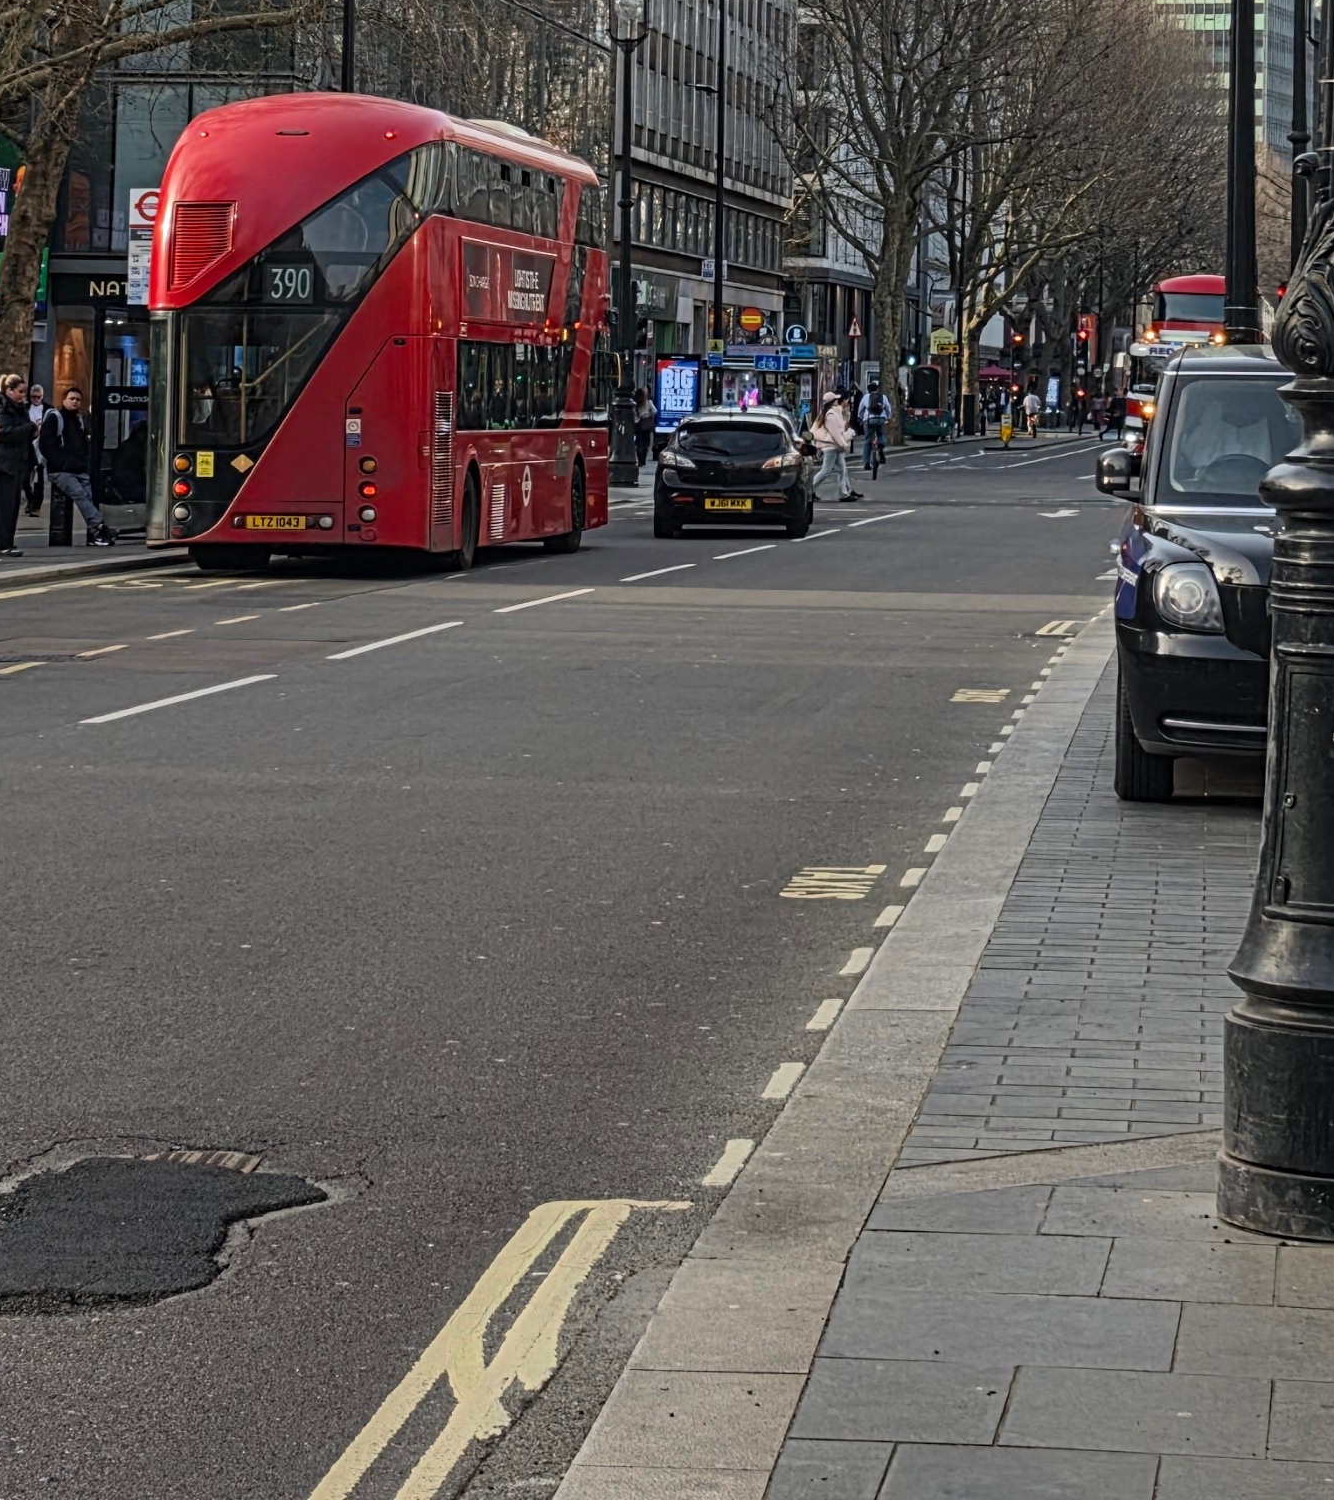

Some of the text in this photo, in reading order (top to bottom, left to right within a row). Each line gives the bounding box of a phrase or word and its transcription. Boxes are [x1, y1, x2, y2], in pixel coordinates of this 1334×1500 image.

[270, 268, 310, 299] 390
[661, 368, 694, 389] BIG
[660, 395, 693, 412] FREEZE
[253, 516, 300, 528] LTZ 1043
